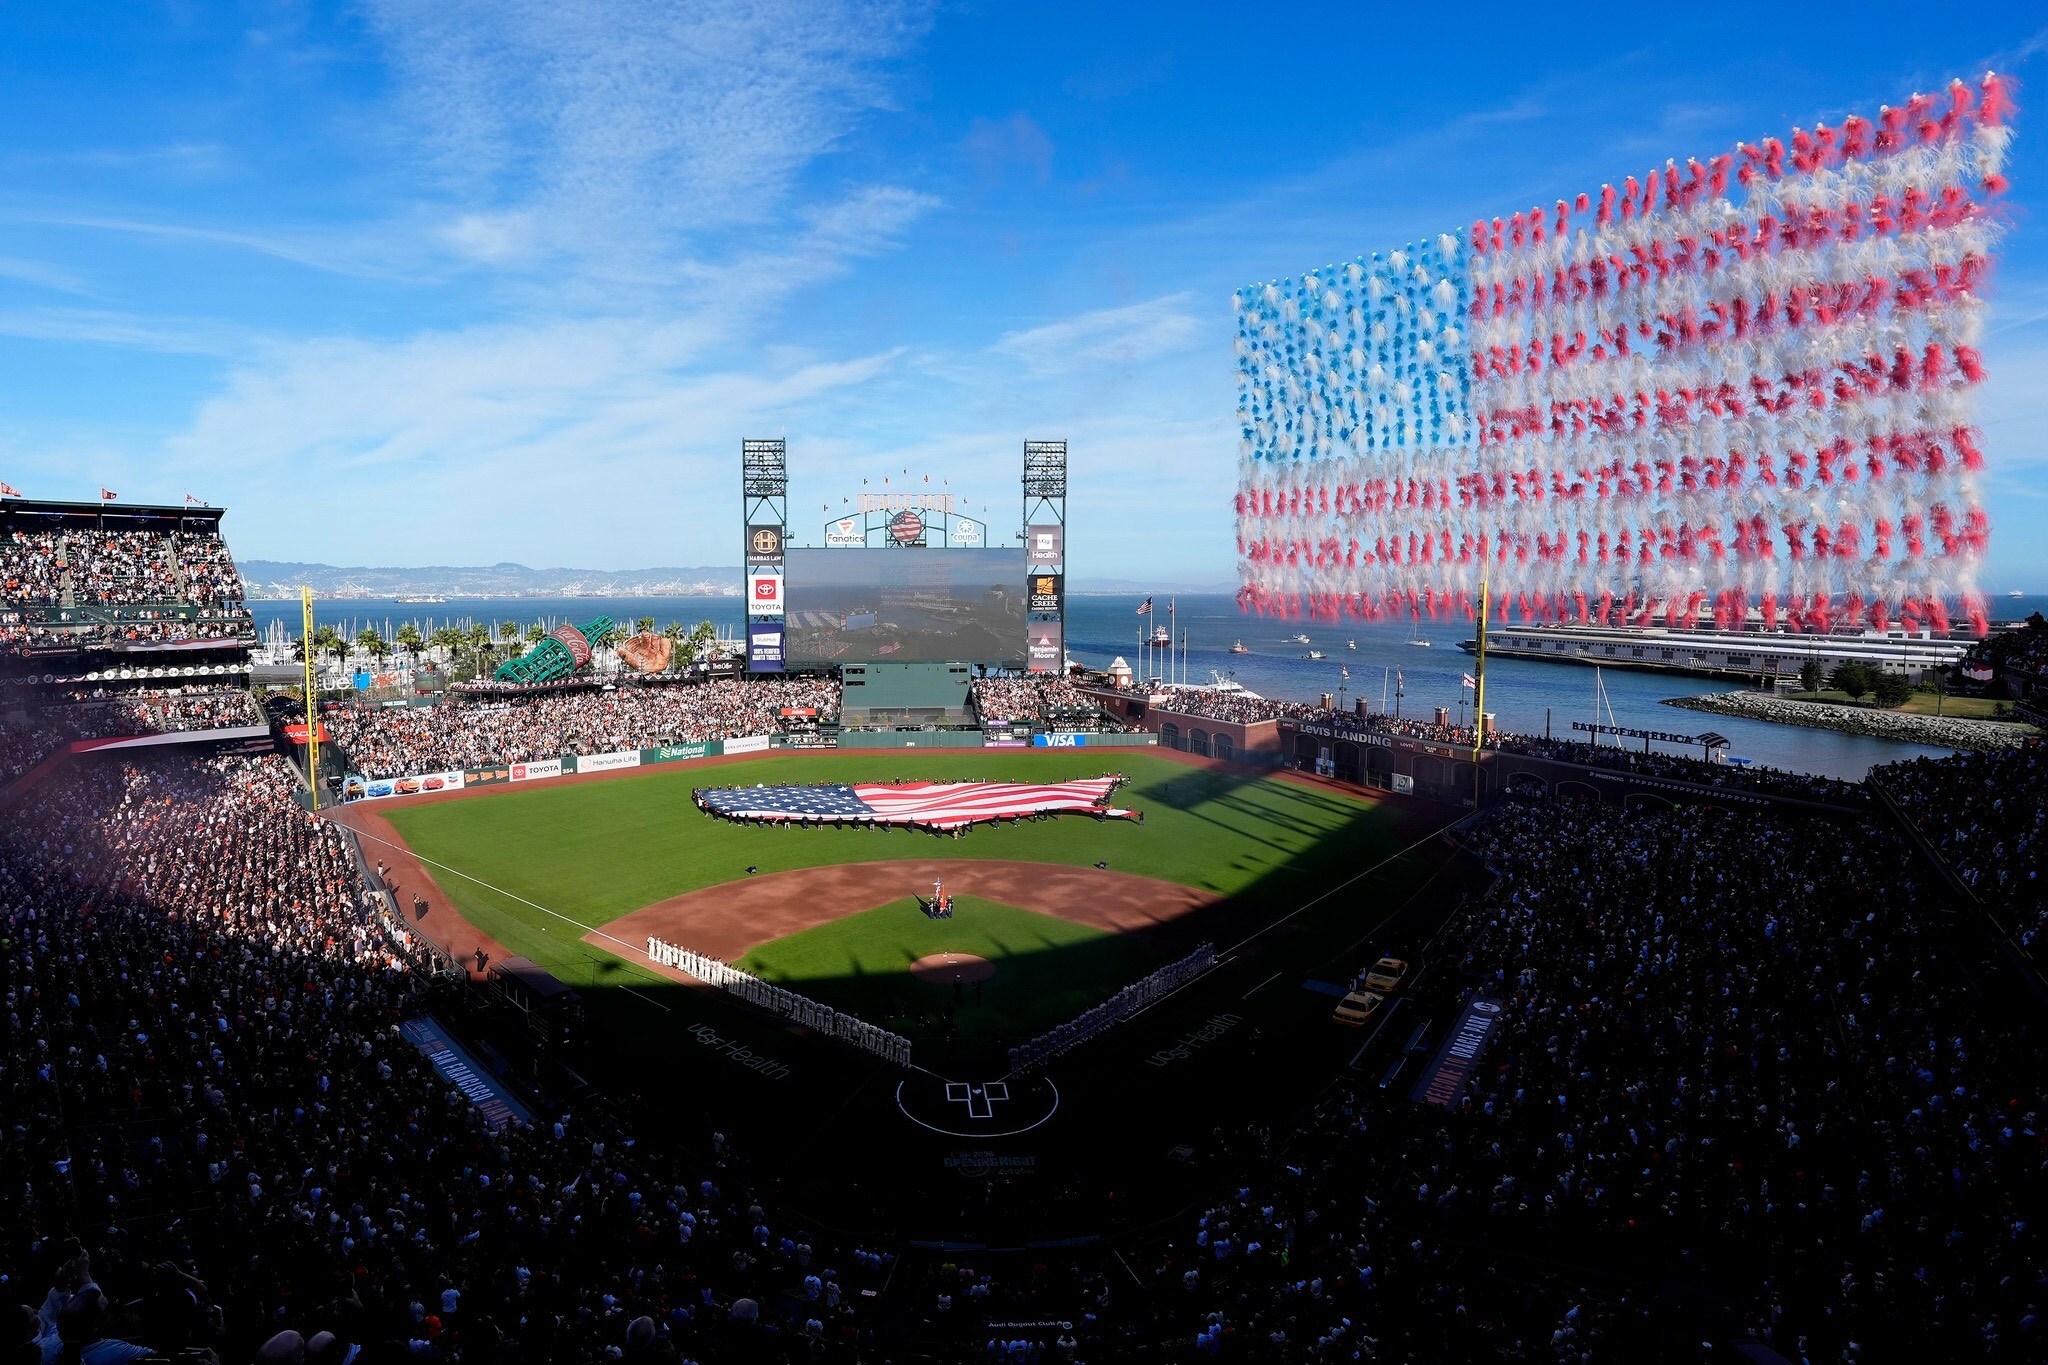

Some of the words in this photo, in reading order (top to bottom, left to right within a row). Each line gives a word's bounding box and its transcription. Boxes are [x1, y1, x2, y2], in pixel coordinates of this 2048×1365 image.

[827, 534, 865, 543] Fanatics
[953, 534, 977, 542] coupa
[1032, 551, 1058, 559] Health
[1030, 645, 1059, 653] Benjamin
[1333, 729, 1392, 748] LANDING
[1572, 721, 1606, 734] BANK
[1609, 726, 1627, 736] OF
[1629, 729, 1694, 744] AMERICA
[1043, 735, 1076, 747] VISA
[671, 744, 706, 757] National
[592, 757, 623, 766] Hanwha
[529, 764, 559, 774] TOYOTA
[1178, 1013, 1244, 1048] Health
[1463, 1014, 1492, 1034] PARK
[1449, 1031, 1483, 1059] ORACLE
[430, 1049, 459, 1066] SAN
[715, 1040, 790, 1080] Health
[442, 1062, 495, 1102] FRANCISCO
[1007, 1321, 1036, 1329] Dugout
